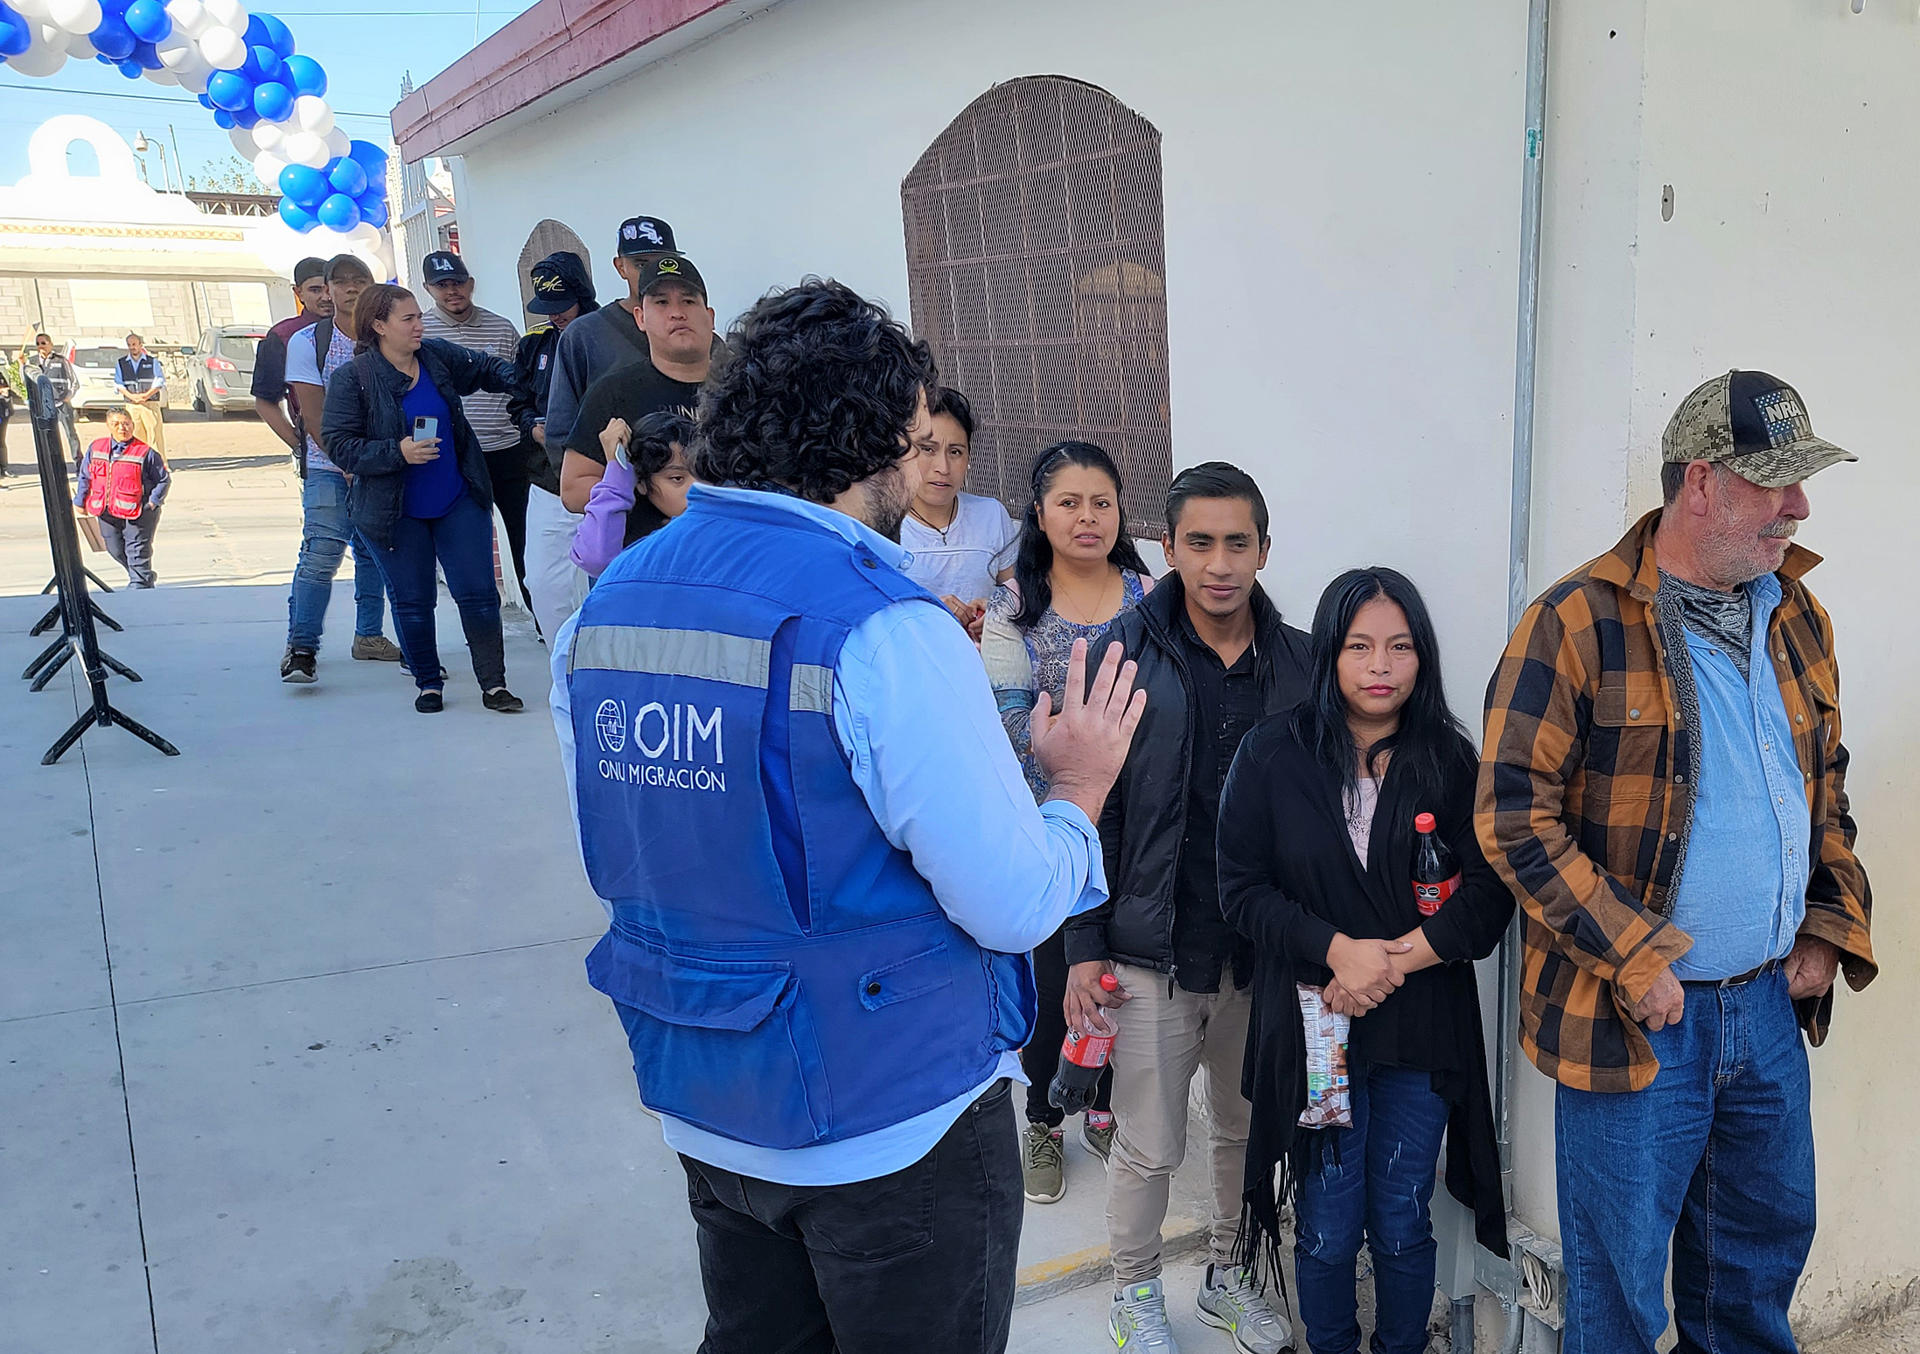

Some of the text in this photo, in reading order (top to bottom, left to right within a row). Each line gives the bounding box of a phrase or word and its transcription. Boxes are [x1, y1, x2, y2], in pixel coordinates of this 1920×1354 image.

[431, 258, 454, 271] LA
[1765, 400, 1802, 423] NRA
[634, 702, 723, 764] OIM
[599, 759, 726, 792] ONU MIGRACIÓN
